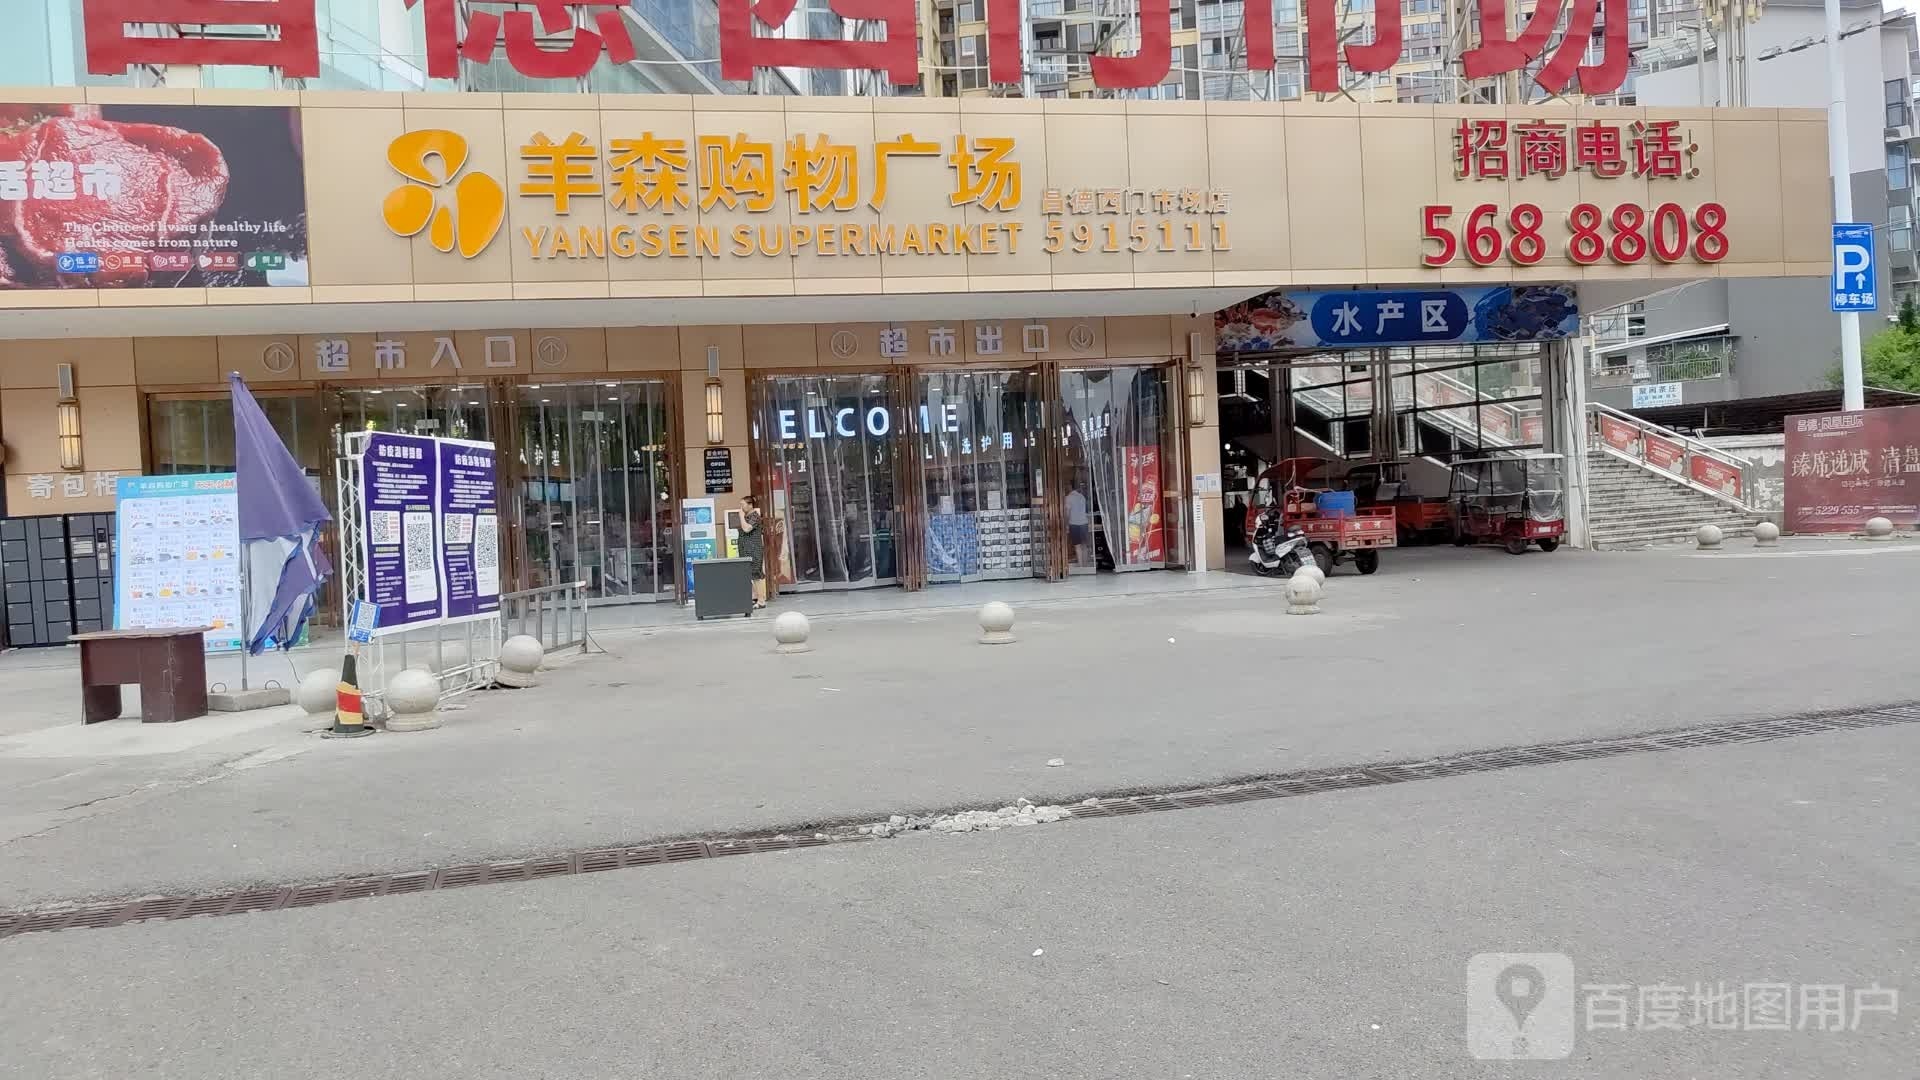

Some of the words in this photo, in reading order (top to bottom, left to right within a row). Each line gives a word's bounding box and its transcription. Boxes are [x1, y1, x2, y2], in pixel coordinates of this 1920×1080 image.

[1452, 117, 1700, 181] 招商电话：
[519, 131, 1023, 215] 羊森购物广场
[1042, 186, 1231, 215] 昌德西门市场店
[64, 221, 92, 233] The
[92, 221, 140, 233] Choice
[142, 221, 157, 233] of
[158, 220, 197, 235] living
[200, 223, 208, 233] a
[209, 220, 261, 235] healthy
[263, 221, 287, 233] life
[64, 237, 110, 249] Health
[112, 240, 156, 249] comes
[158, 237, 190, 249] from
[193, 239, 238, 248] nature
[521, 222, 721, 259] YANGSEN
[730, 221, 1025, 258] SUPERMARKET
[1043, 219, 1232, 254] 5915111
[1421, 203, 1547, 266] 568
[1567, 202, 1730, 265] 8808
[1836, 244, 1870, 290] P
[1835, 292, 1874, 306] 停车场
[1331, 299, 1449, 337] 水产区
[313, 335, 517, 374] 超市入口
[879, 324, 1050, 359] 超市出口
[1815, 505, 1840, 516] 5229
[1840, 505, 1861, 515] 555
